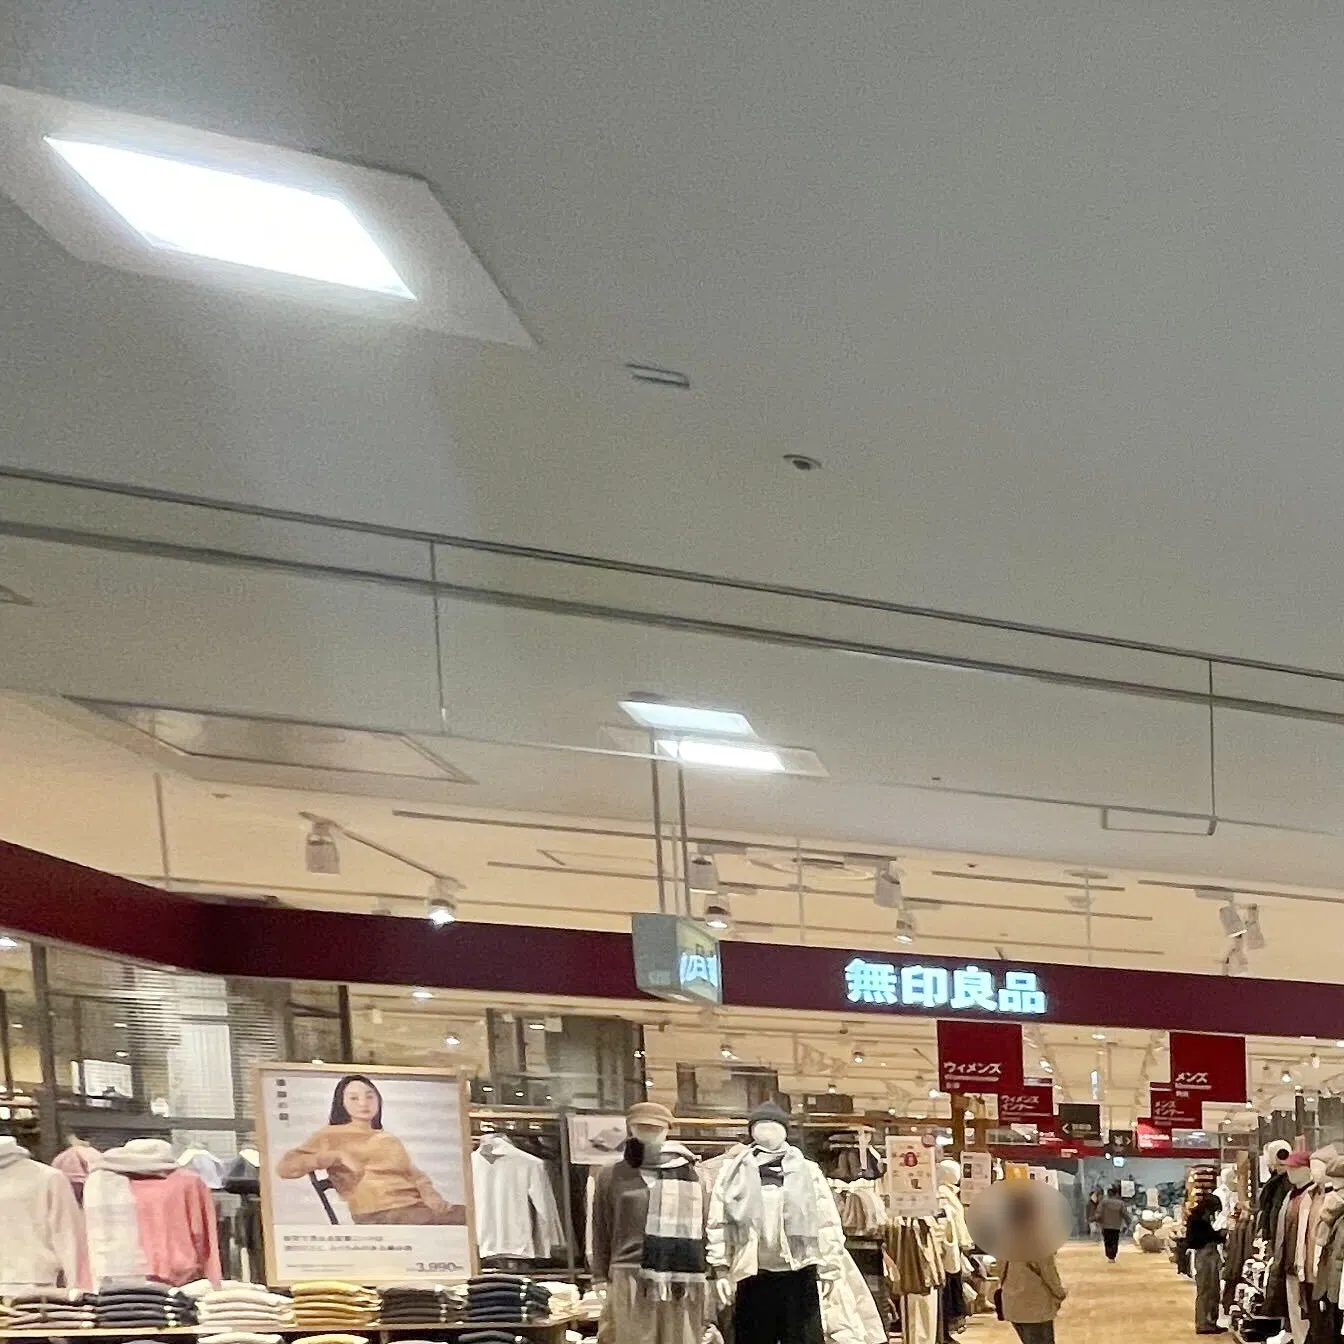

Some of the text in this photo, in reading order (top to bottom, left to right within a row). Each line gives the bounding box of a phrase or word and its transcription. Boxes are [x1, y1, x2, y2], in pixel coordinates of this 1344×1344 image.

[845, 957, 1047, 1014] 無印良品
[944, 1062, 1002, 1075] ウィメンズ
[1175, 1072, 1208, 1083] メンズ
